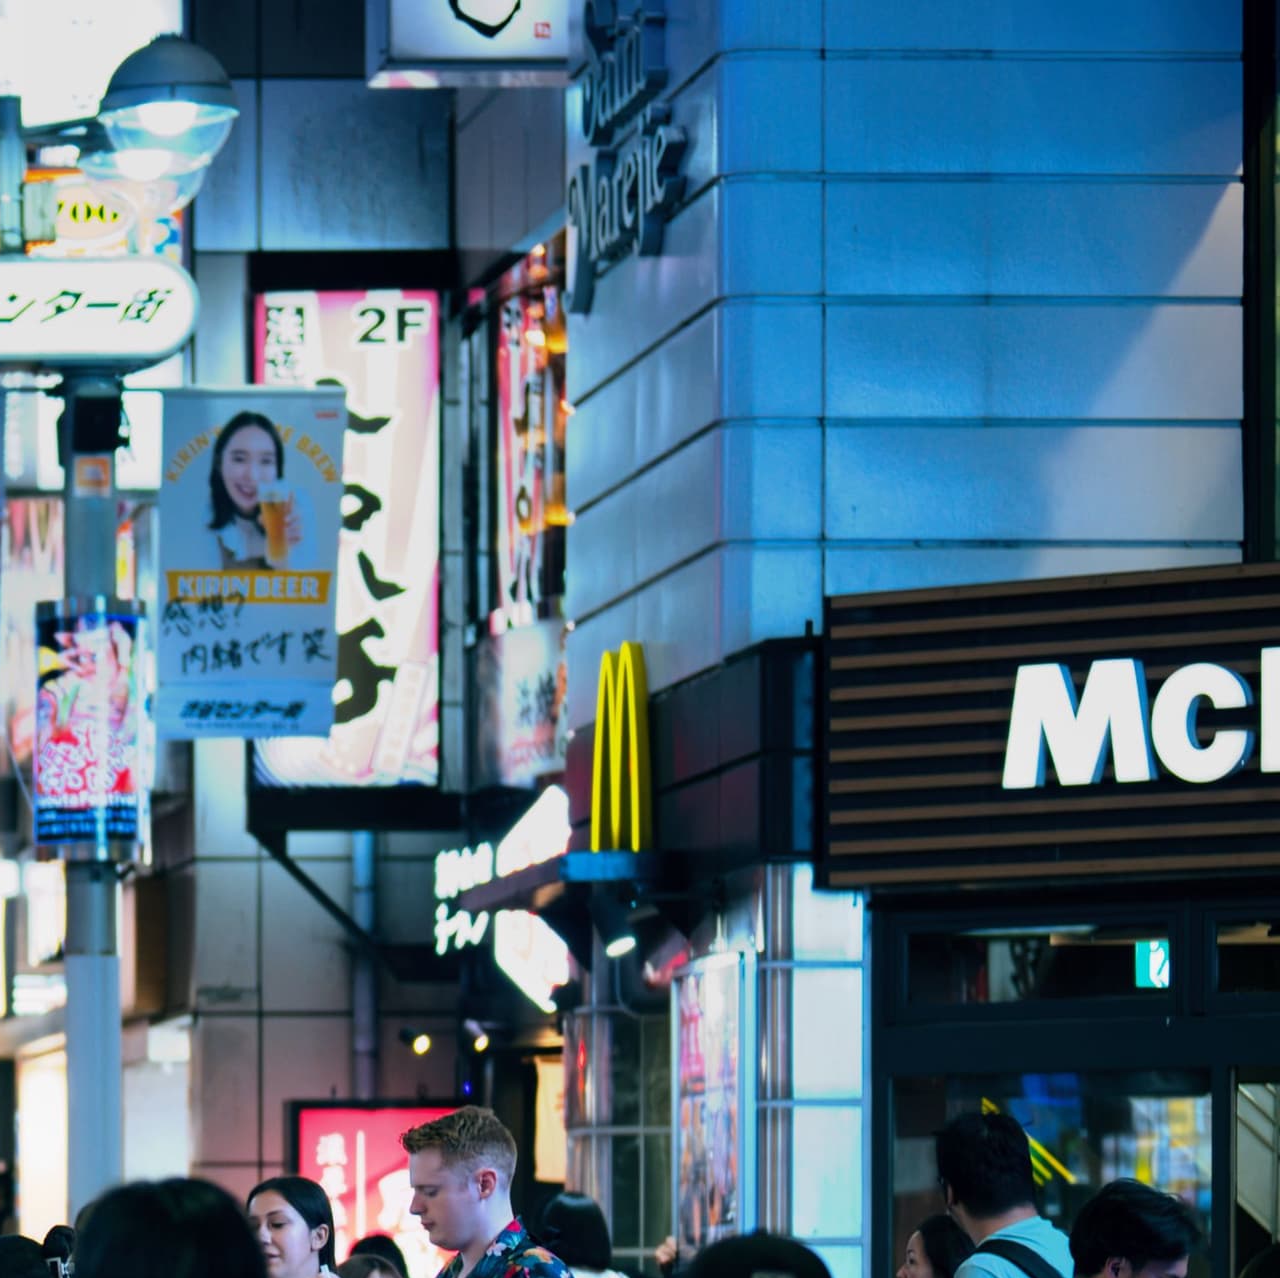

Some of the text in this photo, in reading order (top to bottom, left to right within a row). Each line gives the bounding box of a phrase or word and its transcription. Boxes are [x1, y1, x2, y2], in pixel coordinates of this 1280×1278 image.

[357, 306, 427, 344] 2F
[177, 575, 321, 599] KIRIN BEER
